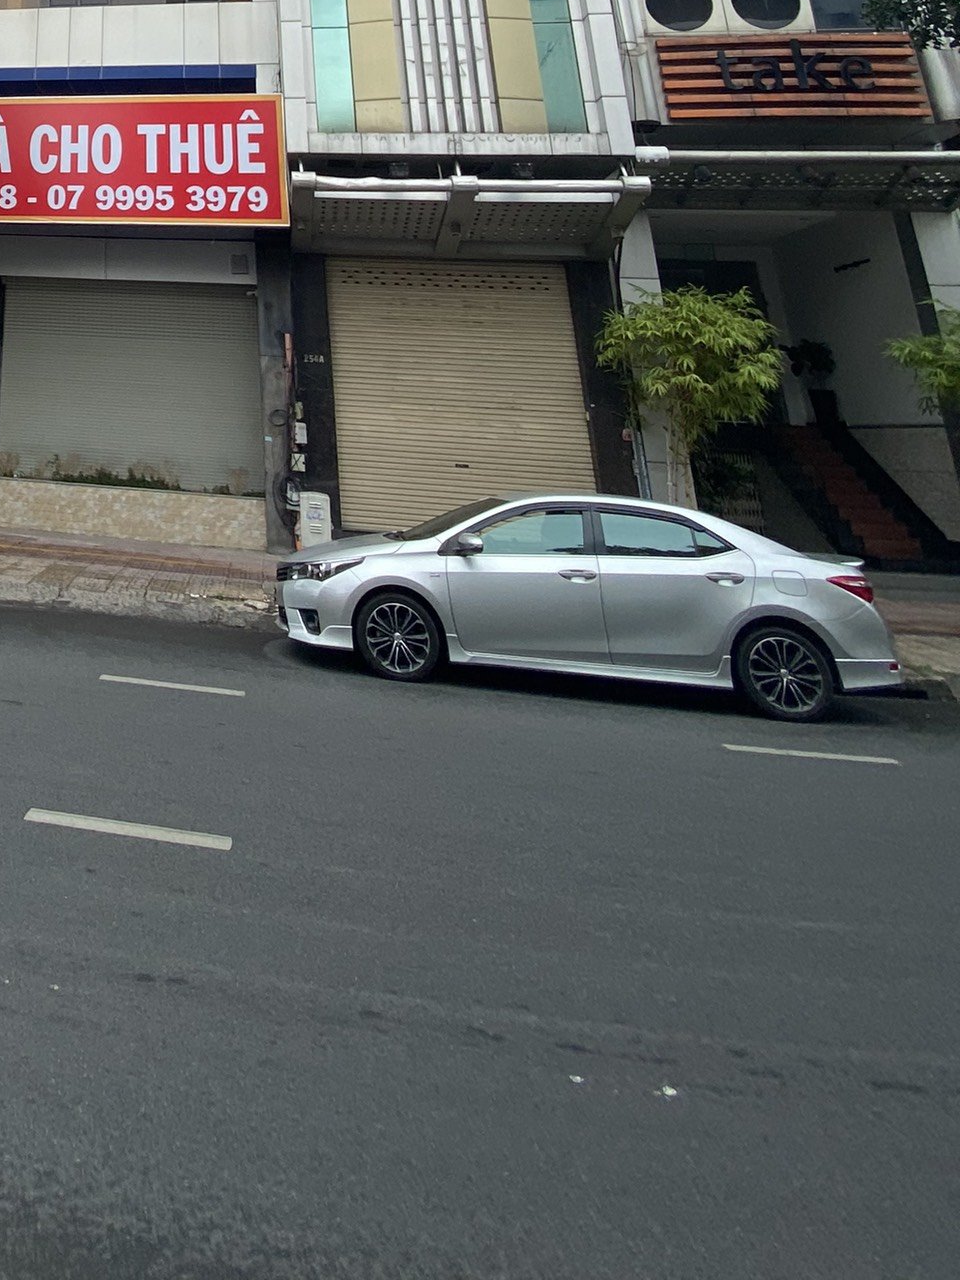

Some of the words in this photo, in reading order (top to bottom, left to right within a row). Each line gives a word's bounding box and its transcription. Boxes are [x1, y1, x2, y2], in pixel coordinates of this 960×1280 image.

[715, 39, 876, 90] take
[29, 124, 123, 174] CHO
[137, 109, 266, 174] THUÊ
[47, 185, 85, 210] 07
[95, 185, 175, 211] 9995
[185, 185, 269, 212] 3979
